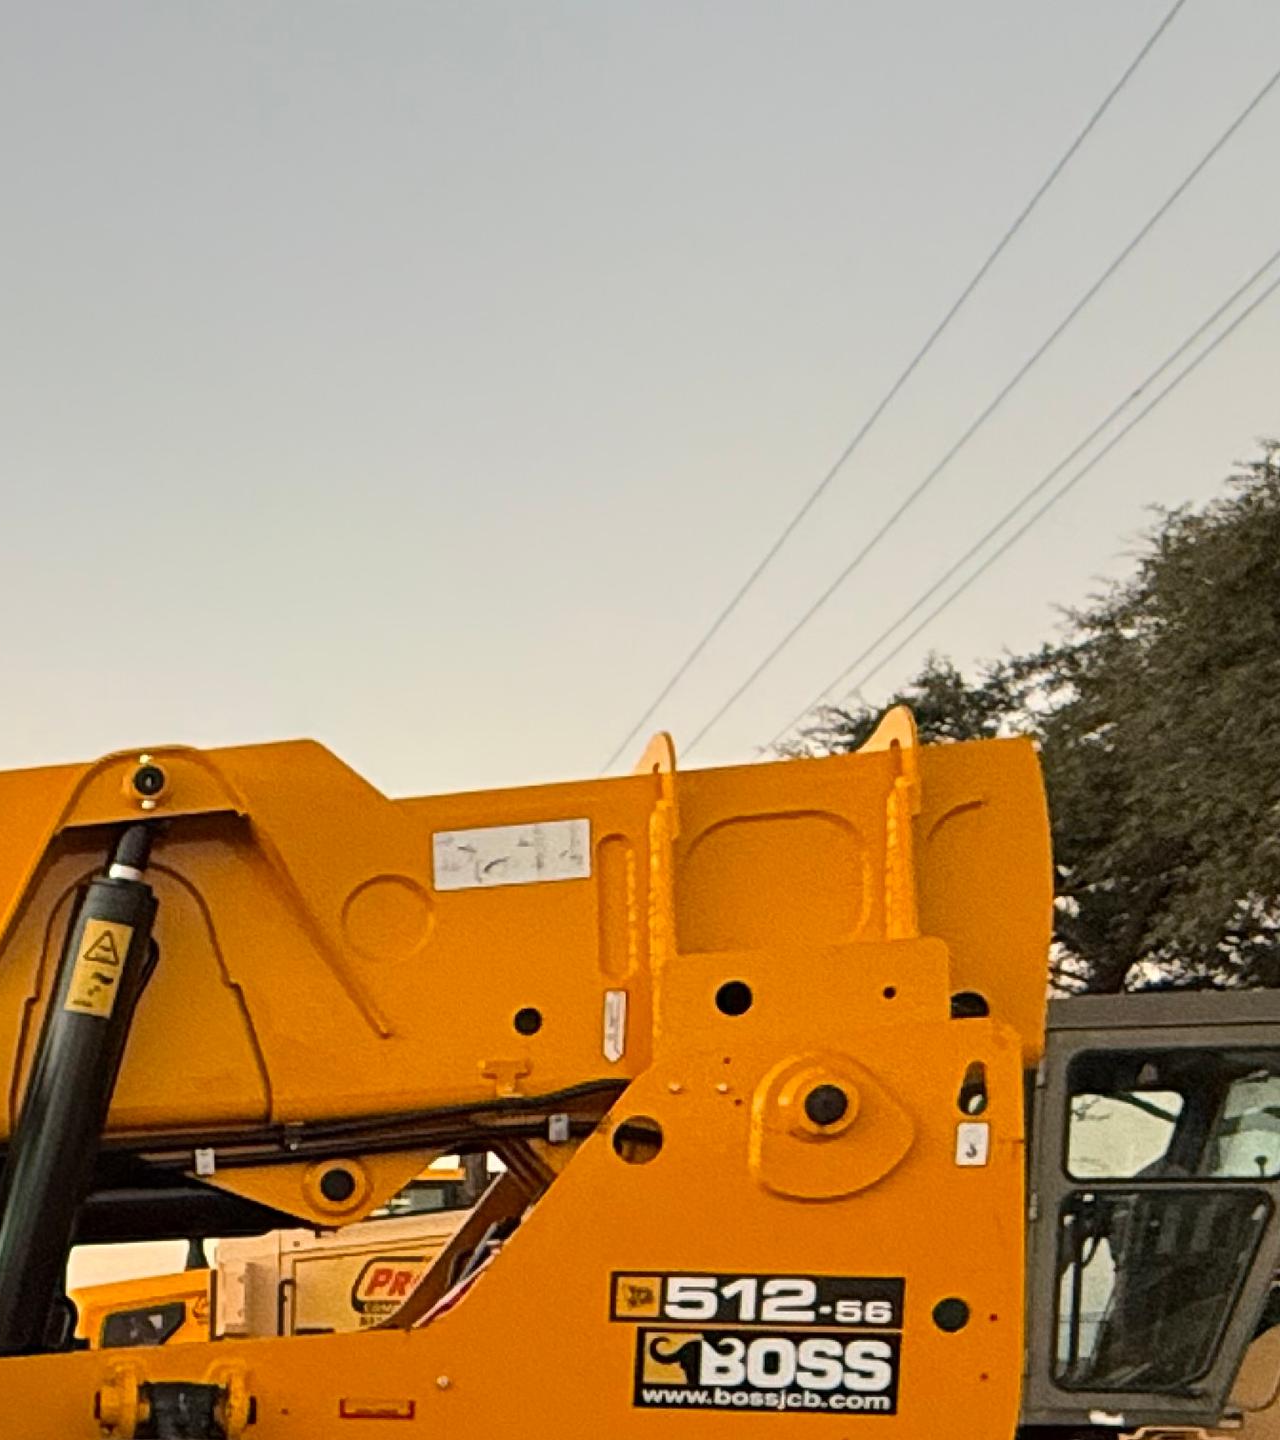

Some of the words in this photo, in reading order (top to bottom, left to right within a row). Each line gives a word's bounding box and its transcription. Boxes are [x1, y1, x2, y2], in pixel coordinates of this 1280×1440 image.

[364, 1267, 420, 1297] PR
[699, 1336, 893, 1392] BOSS
[642, 1386, 891, 1411] www.bossjcb.com
